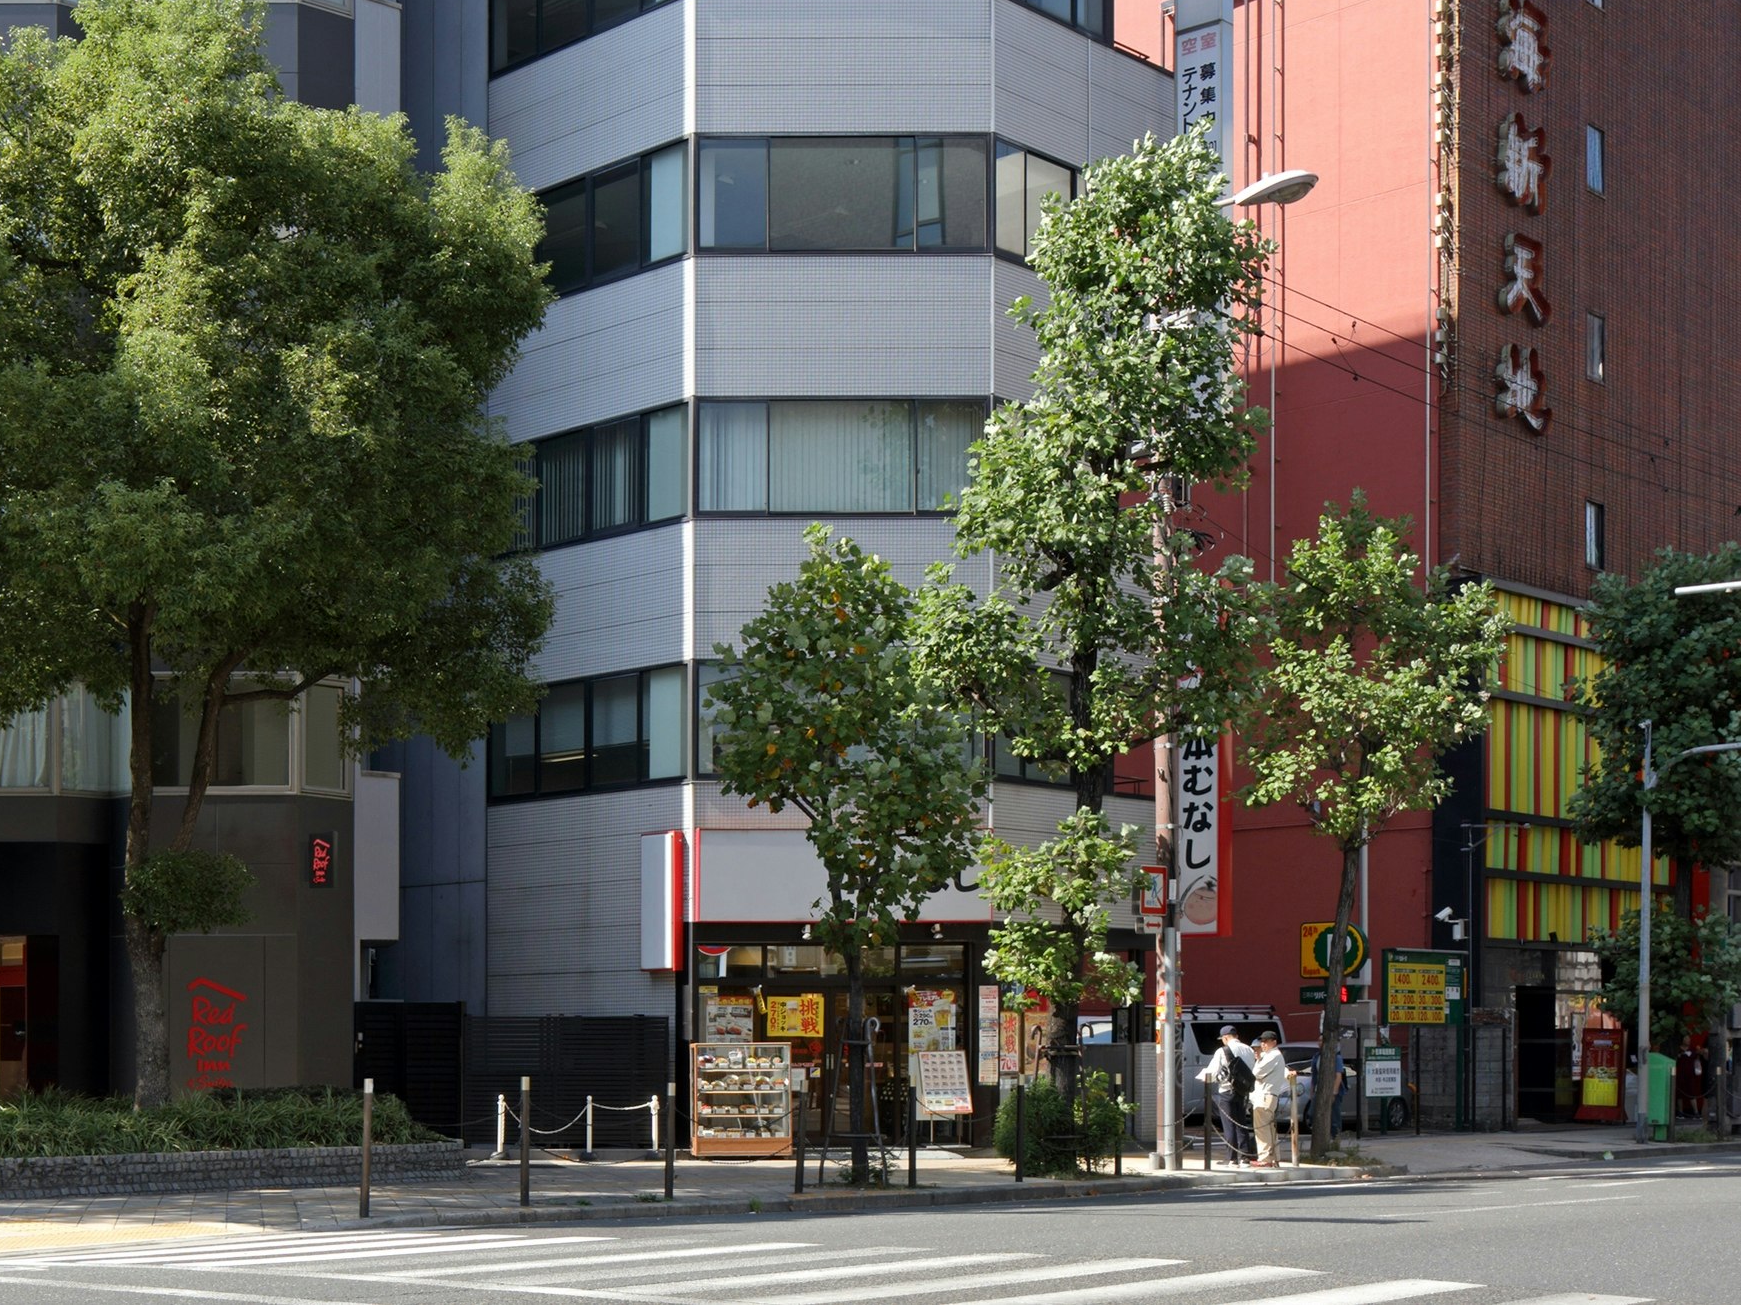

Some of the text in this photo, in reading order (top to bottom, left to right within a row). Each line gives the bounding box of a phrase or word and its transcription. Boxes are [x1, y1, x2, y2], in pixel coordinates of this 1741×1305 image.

[1182, 32, 1217, 56] 空室
[1182, 67, 1198, 135] テナント
[1182, 736, 1214, 869] 本むなし
[192, 995, 236, 1026] Red
[799, 998, 820, 1035] 挑戦
[186, 1023, 248, 1060] Roof
[197, 1058, 231, 1073] Inn
